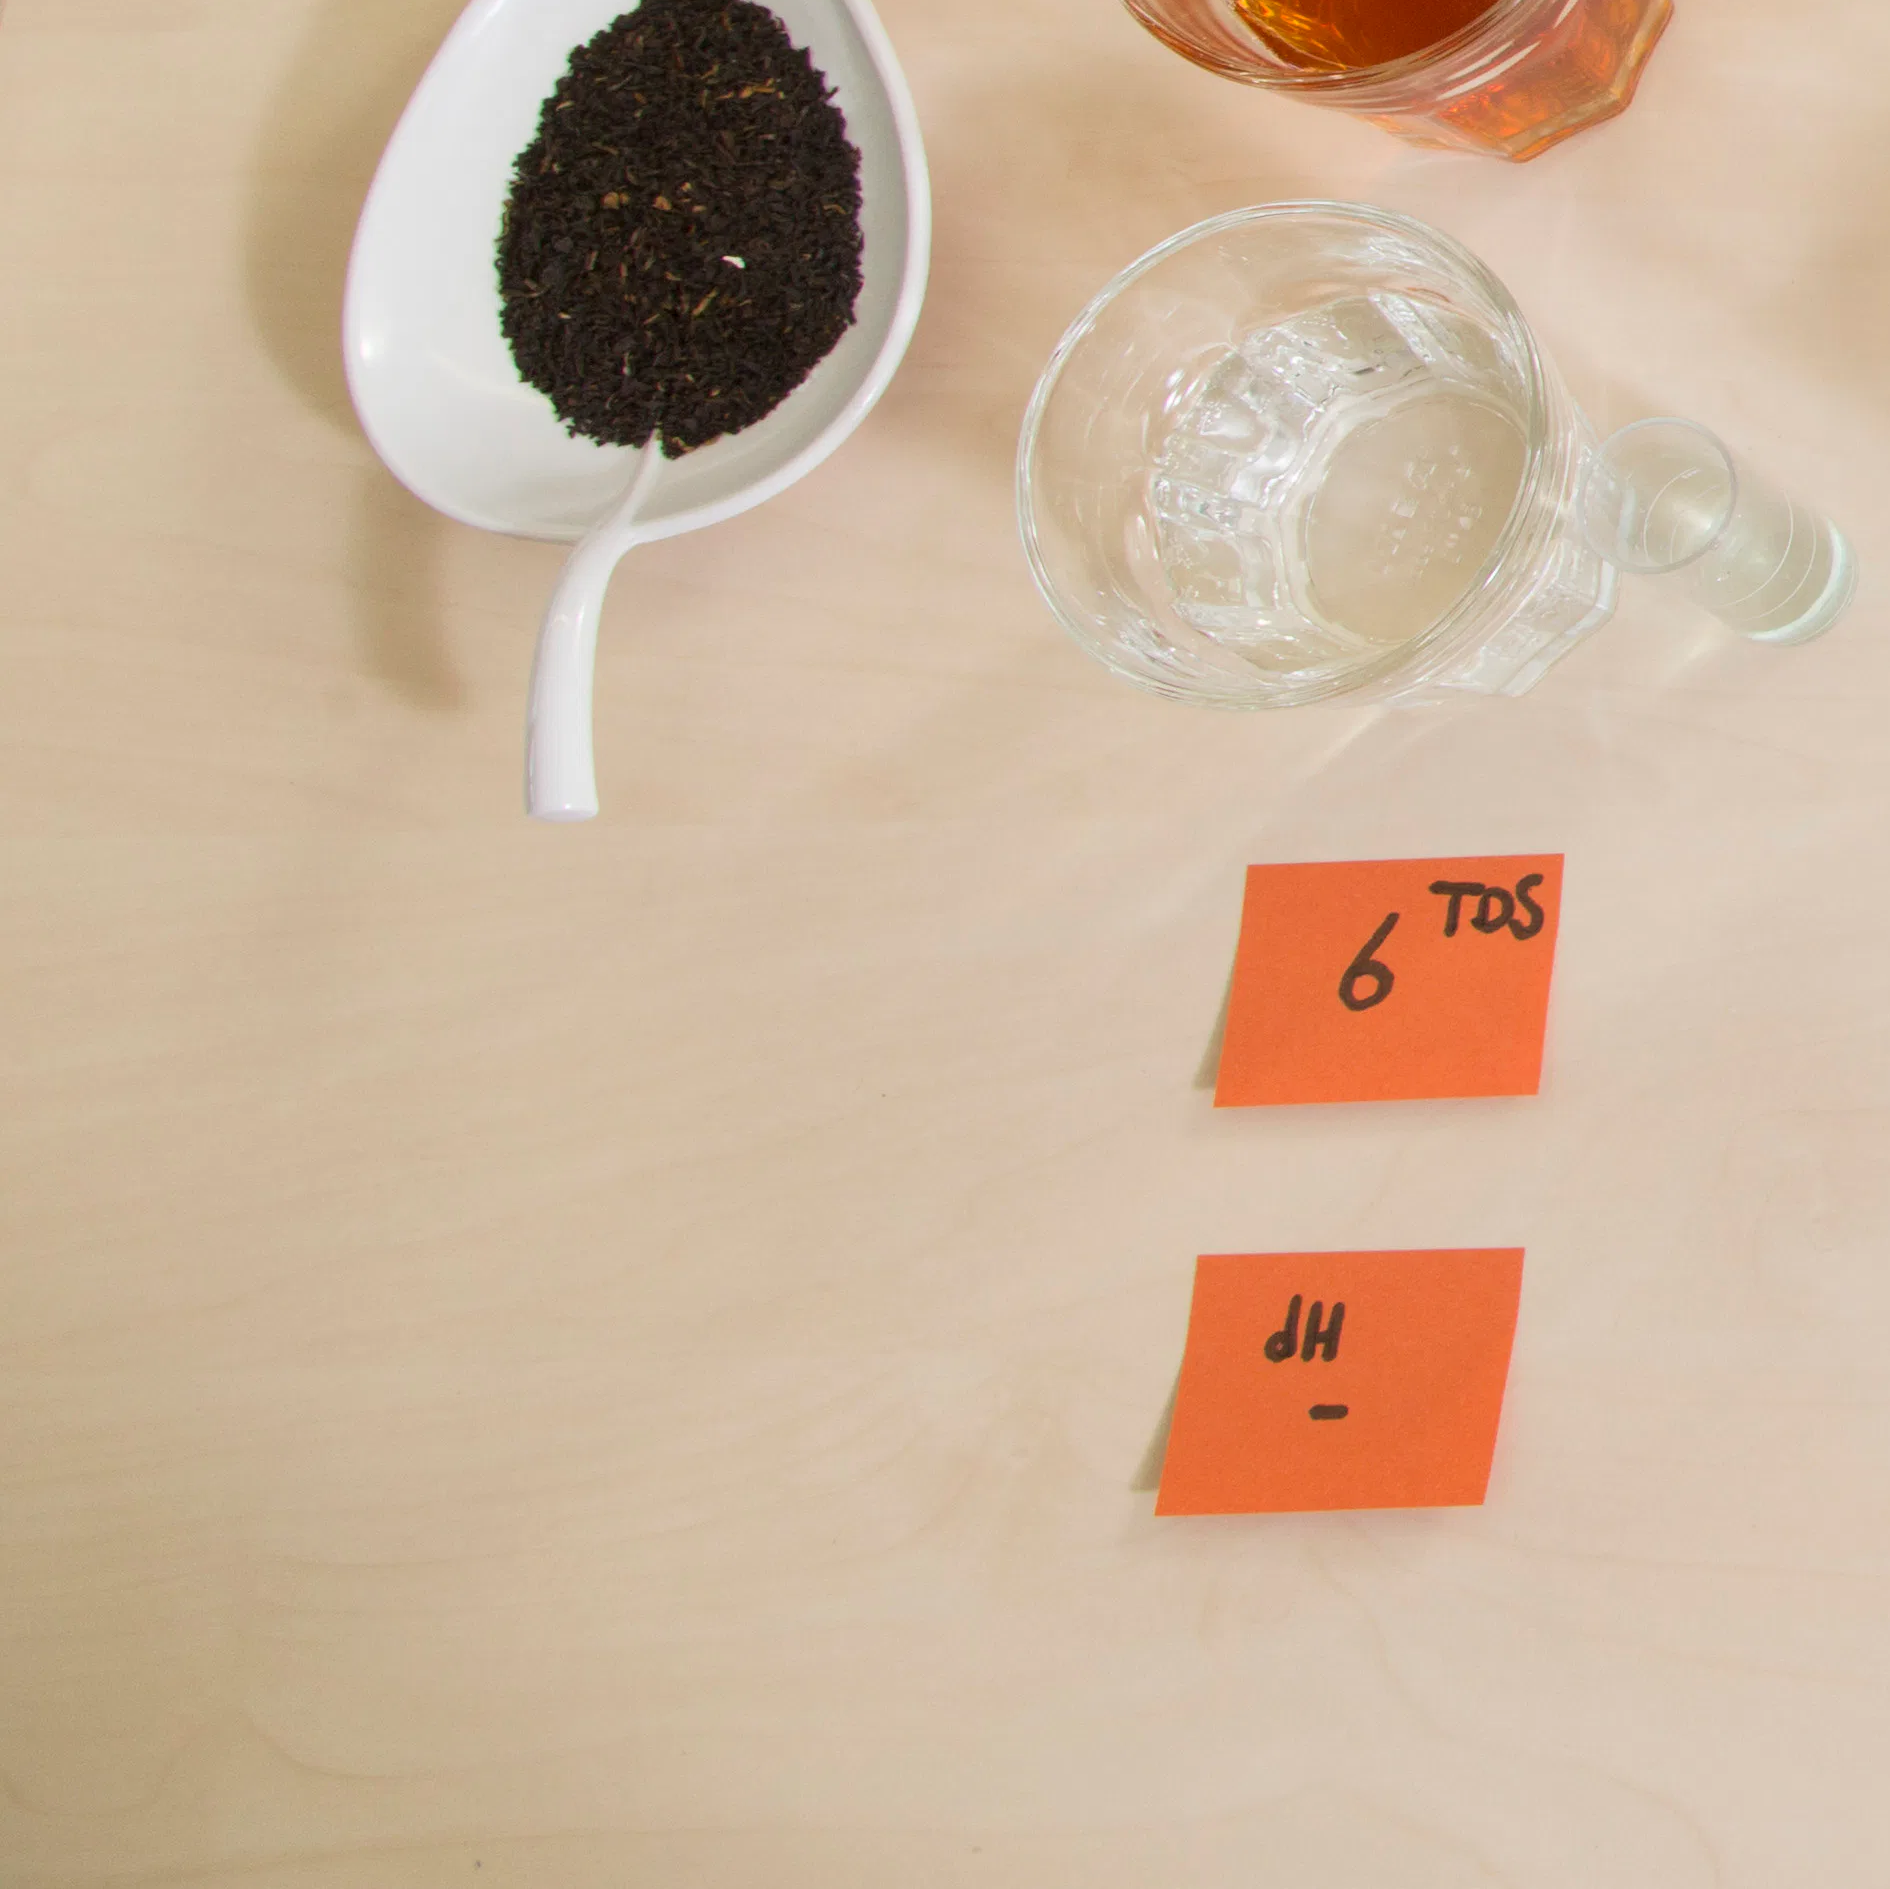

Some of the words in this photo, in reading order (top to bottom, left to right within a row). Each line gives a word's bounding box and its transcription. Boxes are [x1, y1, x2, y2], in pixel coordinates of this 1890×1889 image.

[1428, 873, 1545, 941] TDS
[1338, 912, 1400, 1012] 6
[1263, 1293, 1346, 1364] dH
